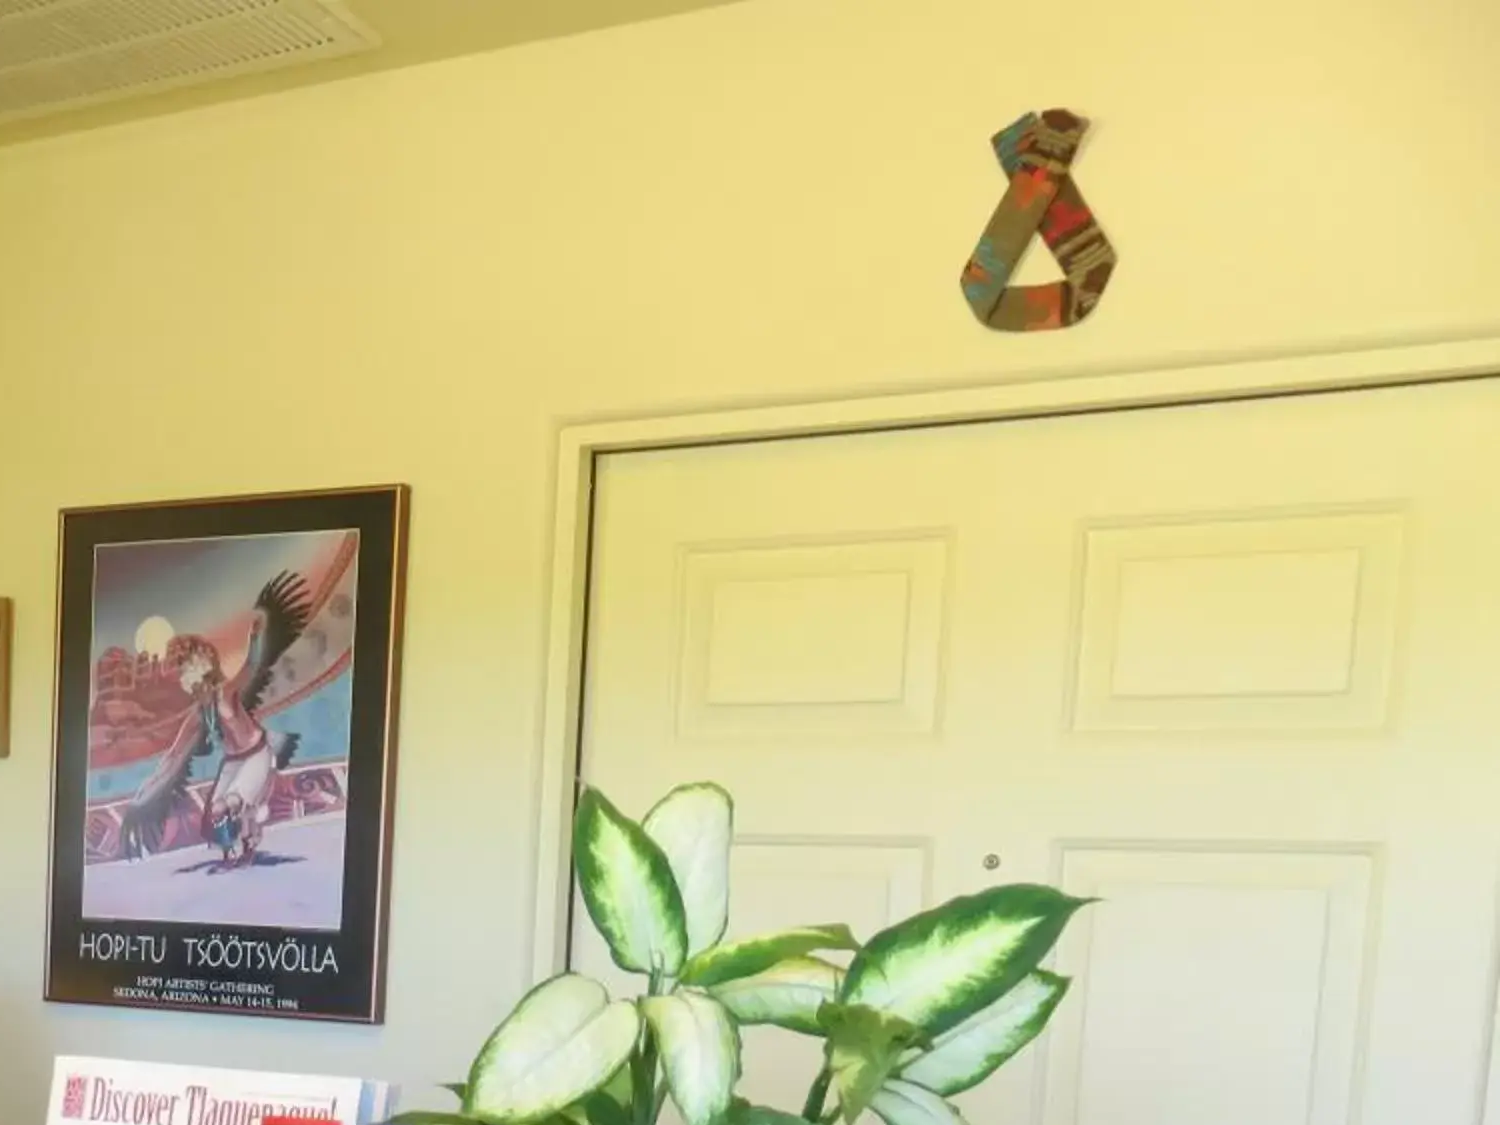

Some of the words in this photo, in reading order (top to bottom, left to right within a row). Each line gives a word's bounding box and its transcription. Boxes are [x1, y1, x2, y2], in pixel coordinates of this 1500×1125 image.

[79, 932, 166, 964] HOPI-TU
[136, 975, 163, 988] HOPI
[209, 981, 275, 995] GATHERING
[220, 994, 244, 1006] MAY
